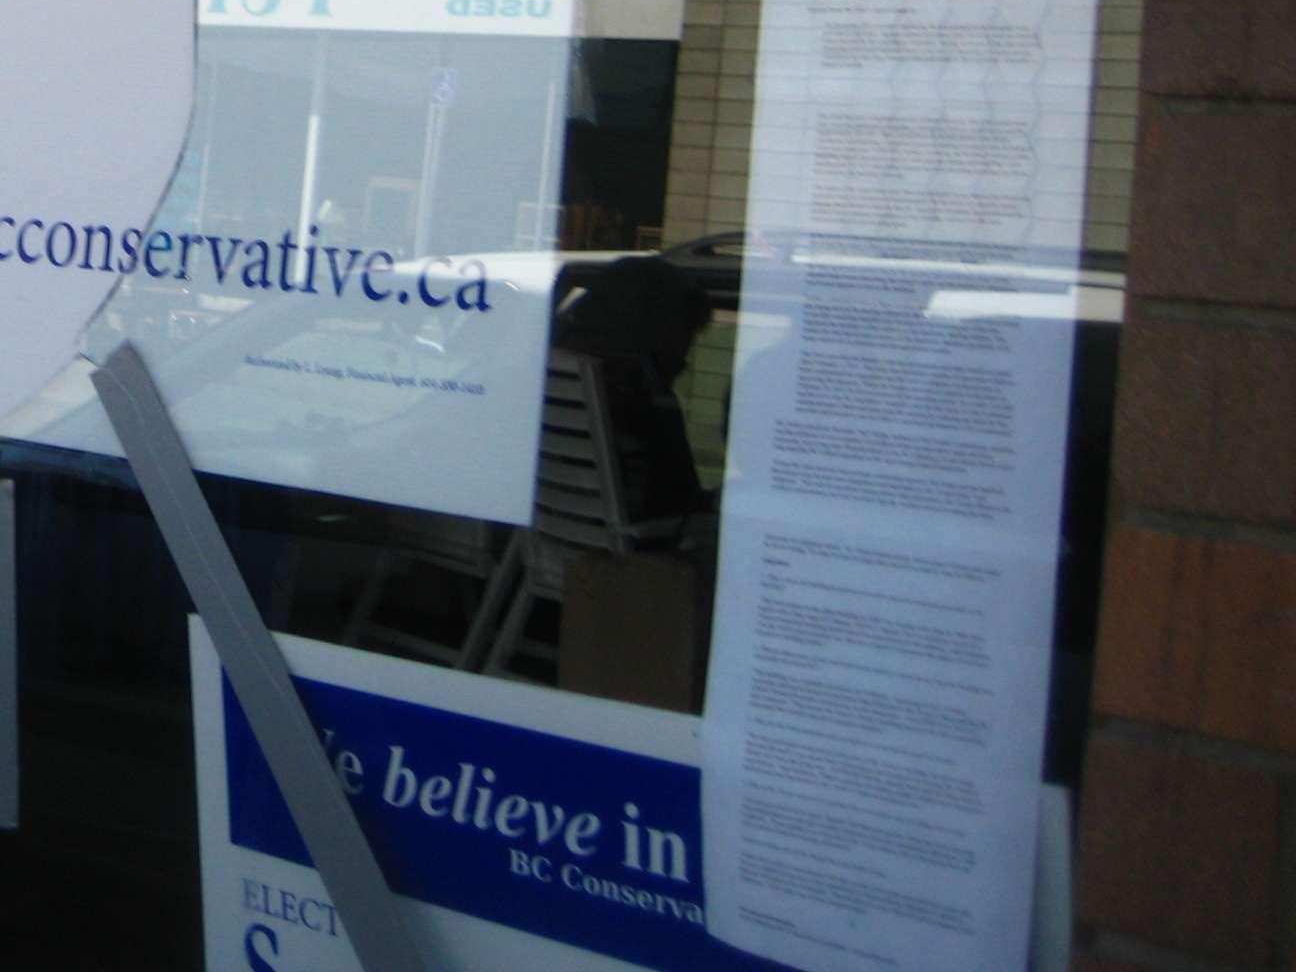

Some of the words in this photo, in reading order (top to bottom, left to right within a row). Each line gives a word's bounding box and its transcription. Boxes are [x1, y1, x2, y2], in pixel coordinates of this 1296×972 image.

[323, 729, 365, 794] e
[382, 744, 601, 856] believe
[620, 802, 690, 883] in
[509, 848, 553, 883] BC
[241, 878, 339, 938] ELECT
